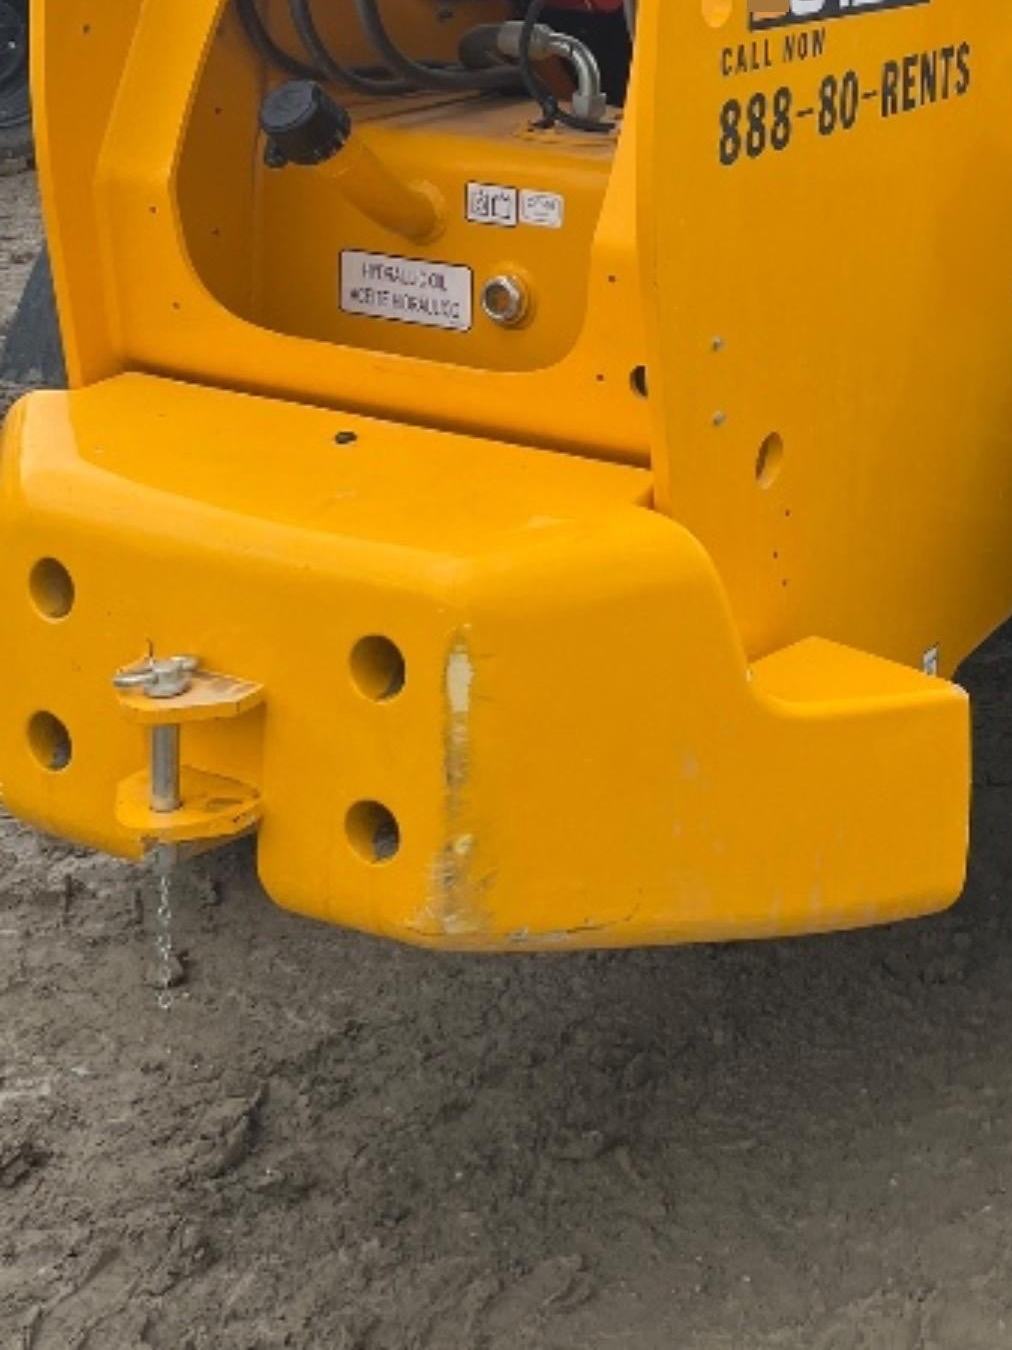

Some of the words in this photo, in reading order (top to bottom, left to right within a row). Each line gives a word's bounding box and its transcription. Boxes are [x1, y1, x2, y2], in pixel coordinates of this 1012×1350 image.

[720, 38, 773, 77] CALL
[783, 26, 826, 63] NOW
[719, 41, 971, 166] 888-80-RENTS
